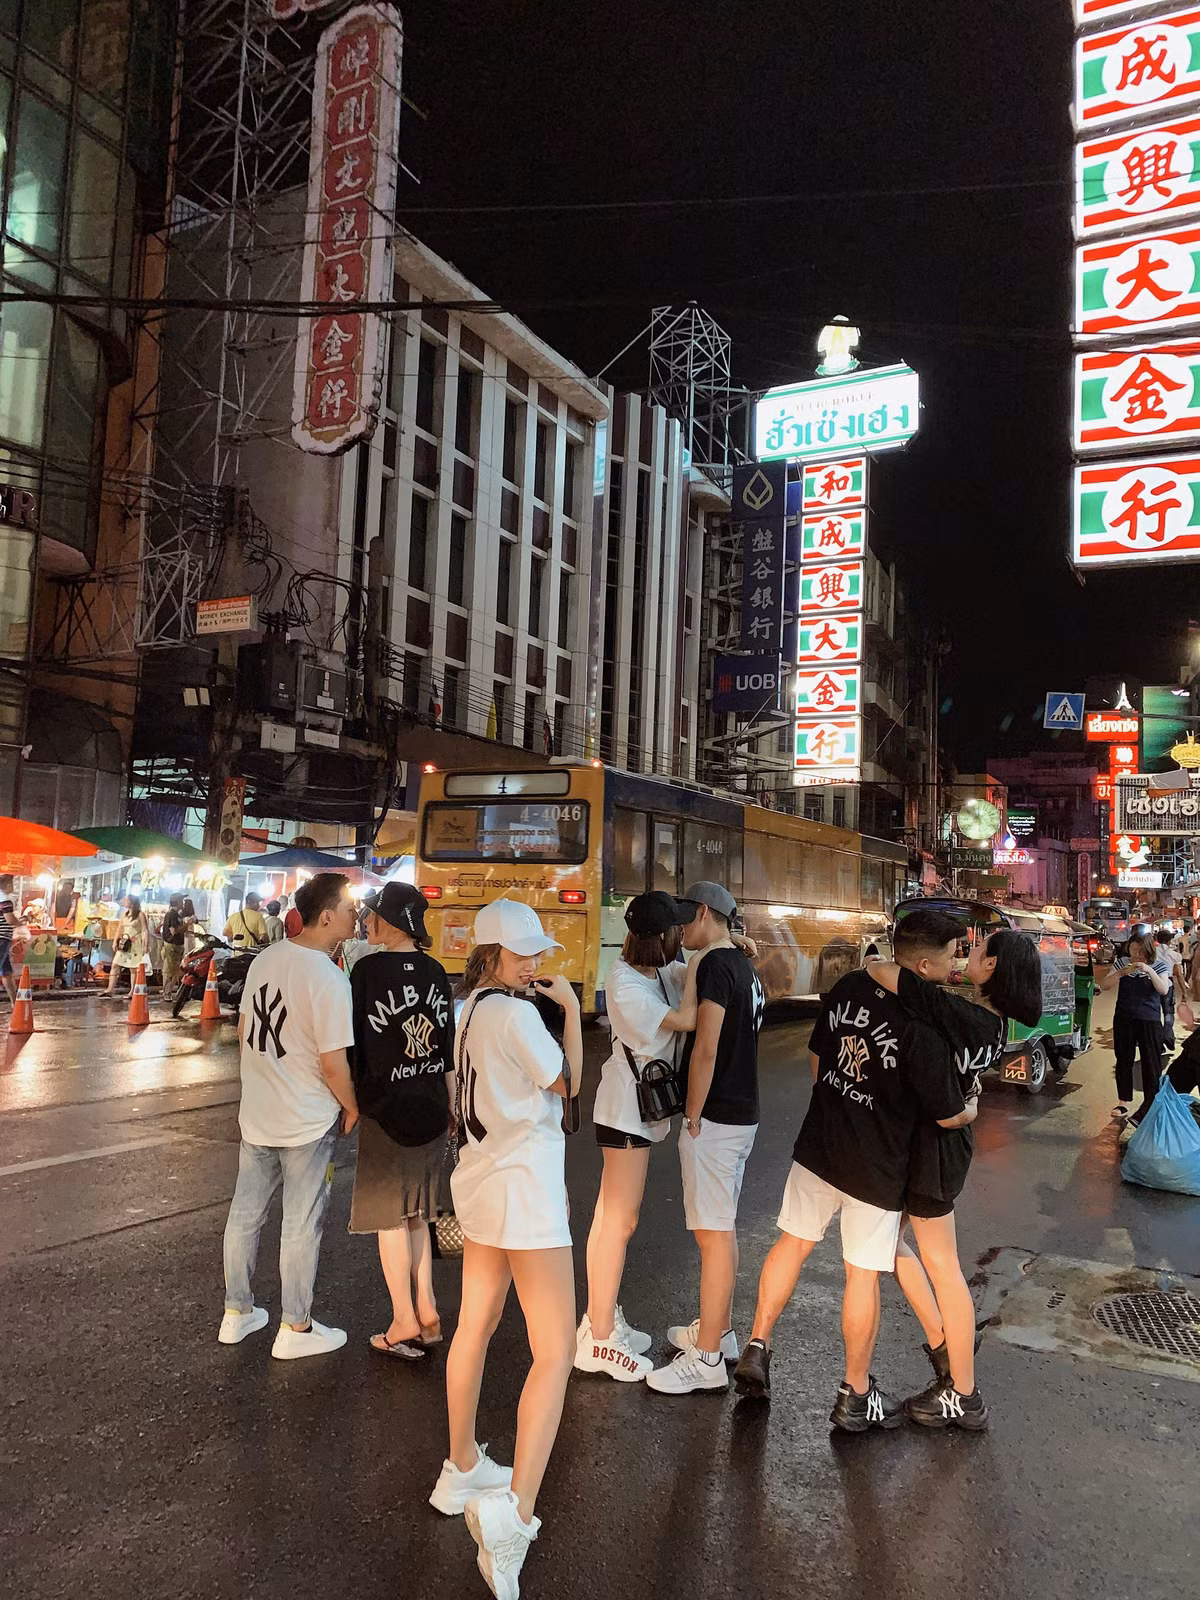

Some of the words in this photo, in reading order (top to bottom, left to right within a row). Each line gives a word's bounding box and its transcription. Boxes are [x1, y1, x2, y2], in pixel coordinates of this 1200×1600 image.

[1109, 35, 1186, 541] 成興大金行
[748, 528, 776, 640] 盤谷銀行
[200, 612, 218, 620] MONEY
[220, 609, 248, 618] EXCHANGE
[810, 470, 850, 760] 和成興大金行
[736, 673, 776, 691] UOB
[498, 776, 508, 794] 4
[520, 805, 582, 822] 4-4046
[696, 839, 723, 854] 4-4046
[1045, 907, 1062, 915] TAXI
[247, 982, 288, 1059] NY
[368, 985, 420, 1033] MLB
[402, 1013, 434, 1059] NY
[391, 1063, 417, 1082] New
[841, 1080, 874, 1111] York
[592, 1345, 639, 1374] BOSTON
[865, 1390, 885, 1422] NY
[938, 1389, 966, 1419] NY
